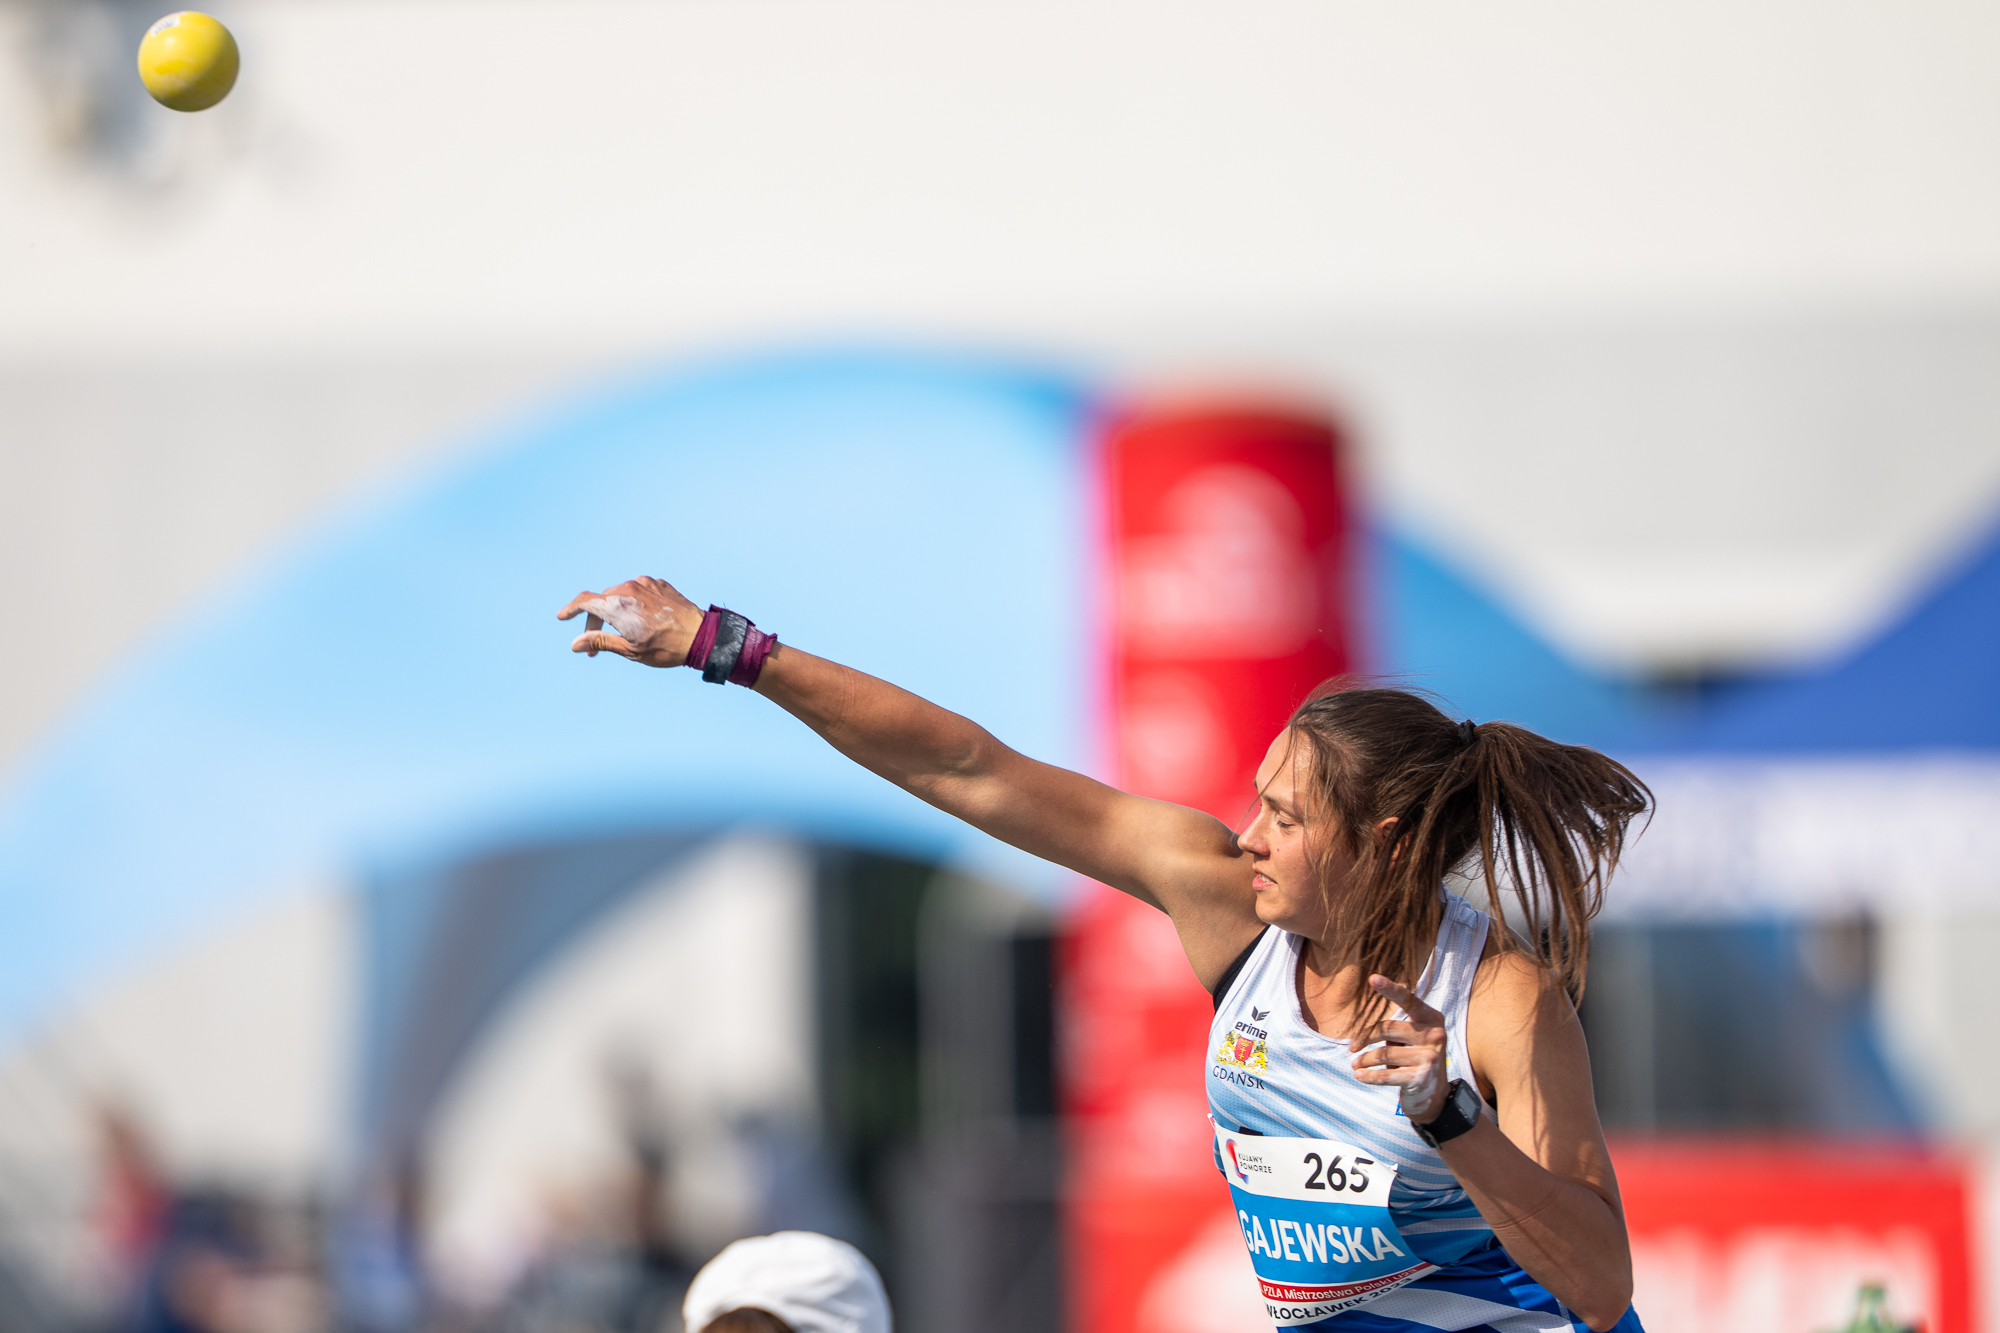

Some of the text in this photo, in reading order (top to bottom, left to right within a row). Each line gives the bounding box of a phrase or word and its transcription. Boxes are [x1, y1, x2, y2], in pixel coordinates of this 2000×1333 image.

[1235, 1021, 1268, 1041] erima
[1212, 1065, 1265, 1091] GDAŃSK
[1238, 1152, 1263, 1164] KUJAWY
[1239, 1161, 1273, 1174] POMORZE
[1303, 1152, 1375, 1193] 265
[1238, 1209, 1406, 1264] GAJEWSKA
[1284, 1288, 1354, 1300] Mistrzostwa
[1354, 1278, 1392, 1294] Polski
[1369, 1277, 1413, 1299] 2023
